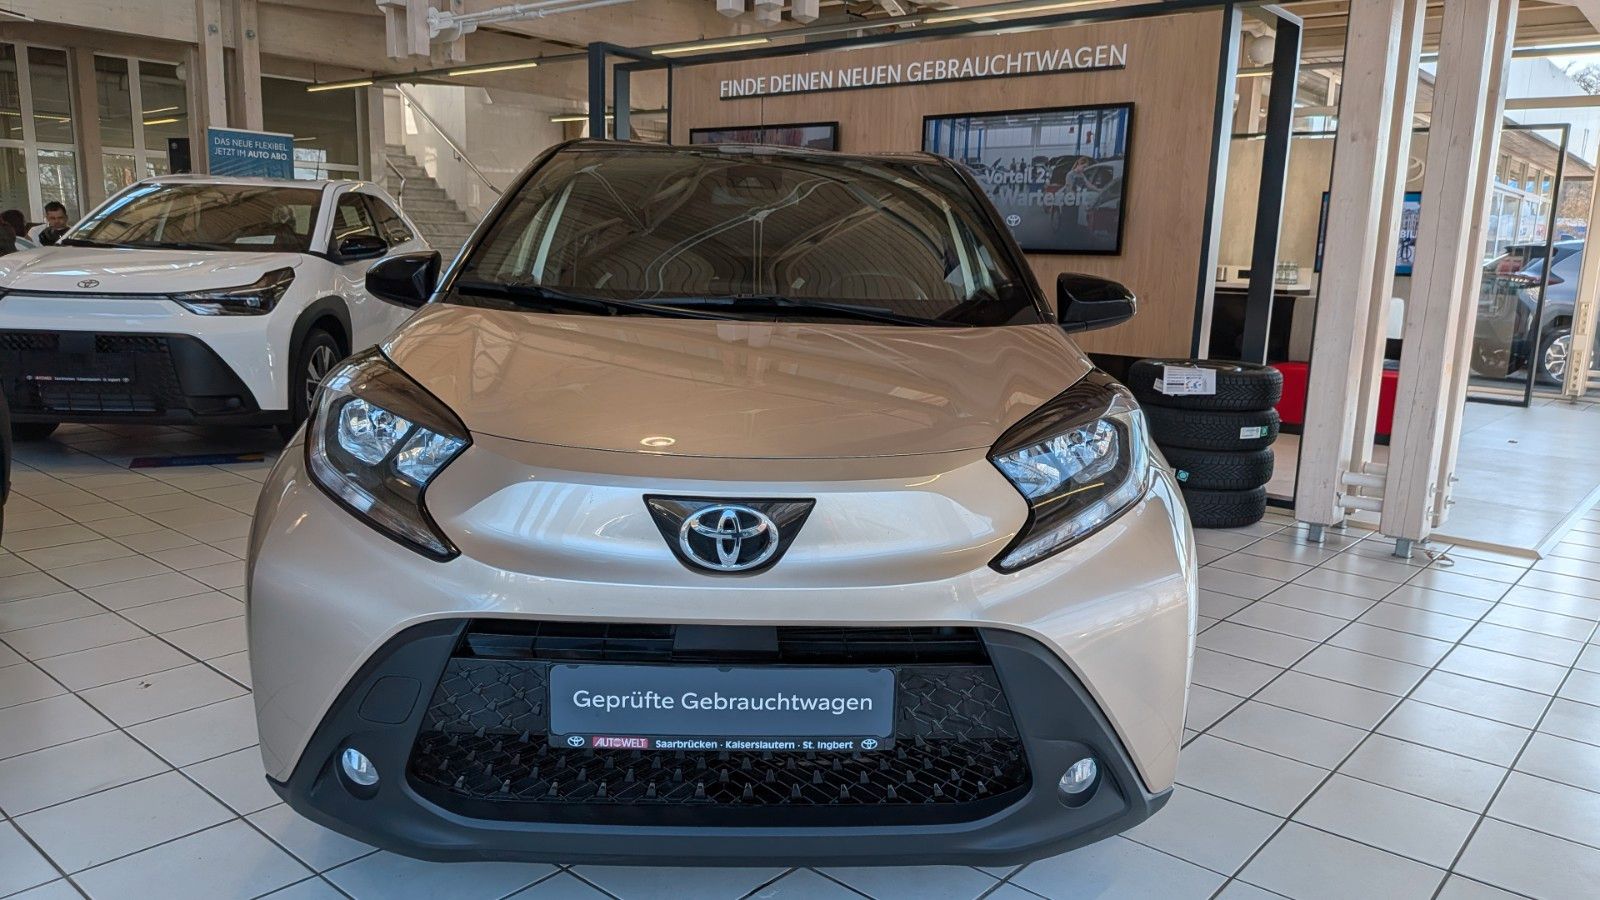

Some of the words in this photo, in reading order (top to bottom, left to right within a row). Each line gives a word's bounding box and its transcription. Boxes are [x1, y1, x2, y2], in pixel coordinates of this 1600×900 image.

[720, 77, 766, 97] FINDE
[770, 70, 833, 93] DEINEN
[837, 64, 901, 88] NEUEN
[906, 43, 1128, 82] GEBRAUCHTWAGEN
[214, 137, 230, 146] DAS
[232, 139, 253, 148] NEUE
[214, 147, 235, 156] JETZT
[236, 149, 247, 157] IM
[247, 150, 270, 159] AUTO
[985, 166, 1033, 185] Vorteil
[1035, 167, 1051, 184] 2:
[572, 689, 675, 713] Geprüfte
[681, 691, 873, 716] Gebrauchtwagen
[594, 737, 647, 749] AUTOWELT
[655, 740, 718, 749] Saarbrücken
[725, 741, 795, 749] Kaiserslautern
[802, 741, 815, 749] St.
[817, 741, 853, 751] Ingbert
